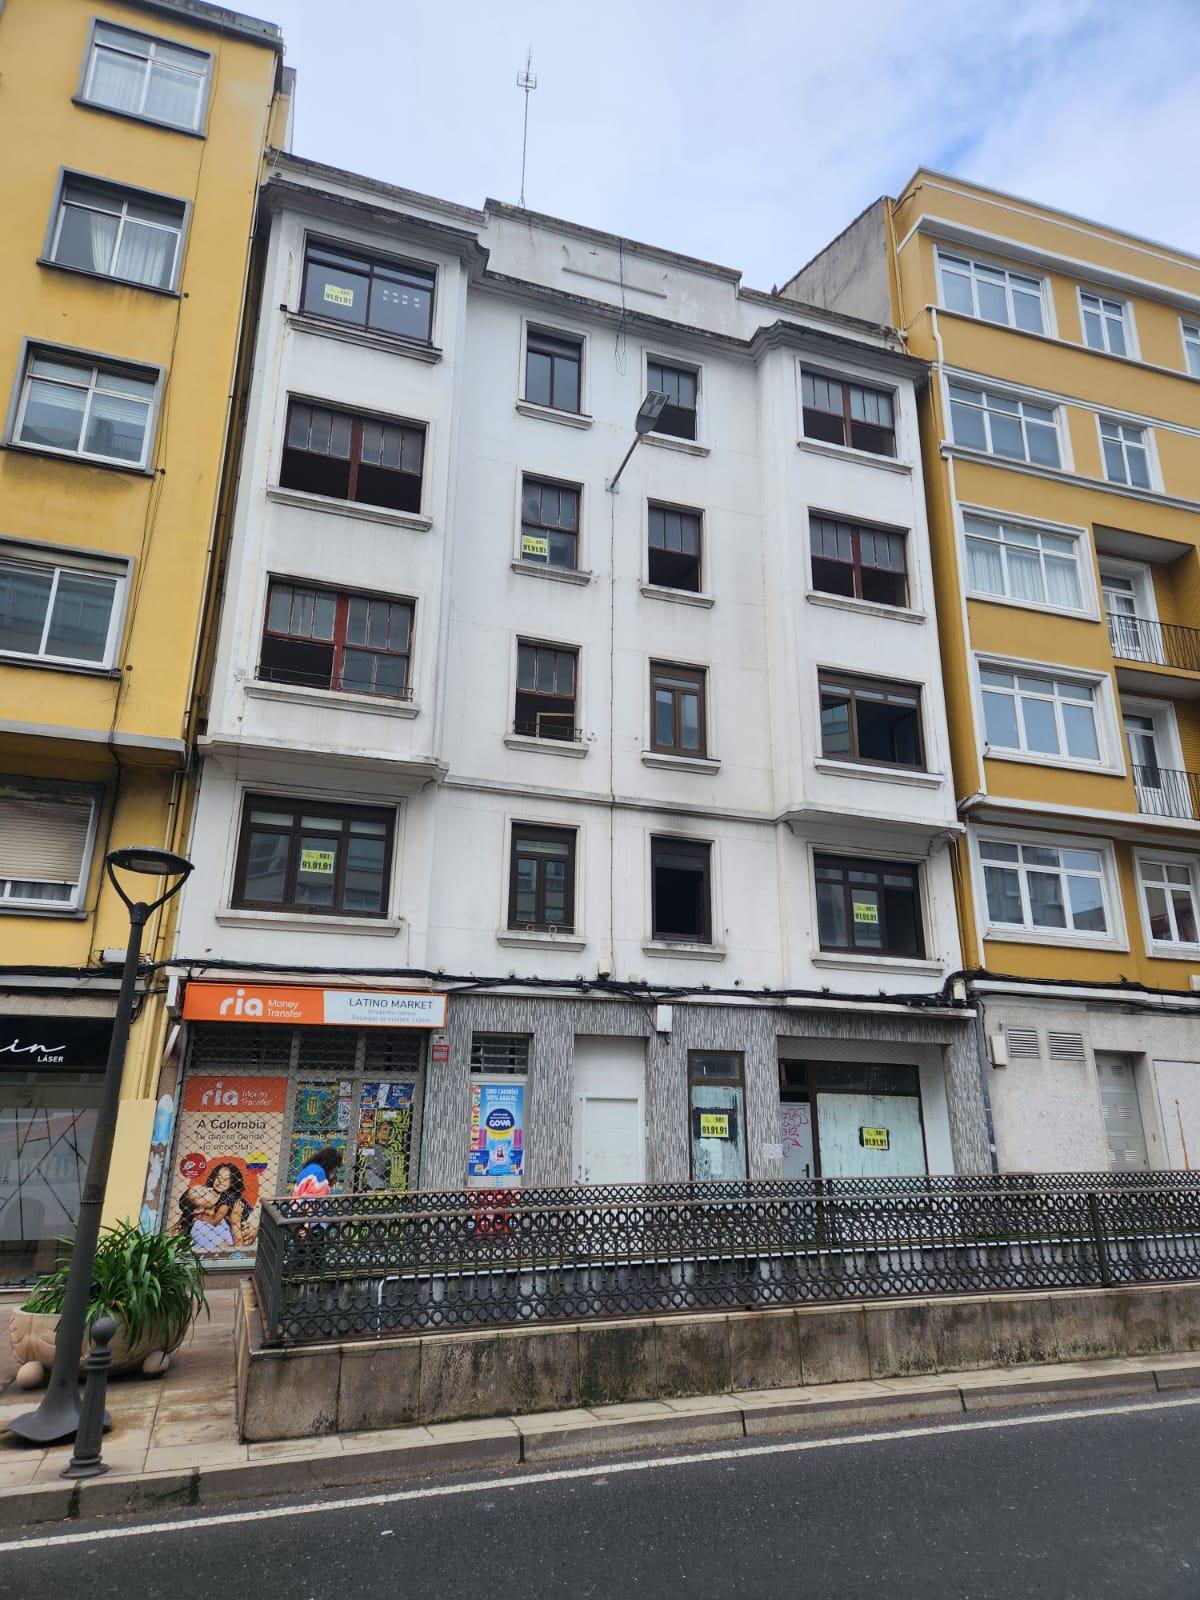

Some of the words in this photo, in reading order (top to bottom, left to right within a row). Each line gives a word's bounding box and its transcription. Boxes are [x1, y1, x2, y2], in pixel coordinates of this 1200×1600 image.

[219, 988, 264, 1017] ria
[267, 999, 299, 1010] Money
[349, 997, 388, 1008] LATINO
[391, 1000, 433, 1010] MARKET
[267, 1008, 303, 1018] Transfer
[37, 1055, 64, 1063] LÁSER
[201, 1082, 238, 1106] ria
[242, 1089, 268, 1098] Money
[240, 1098, 272, 1107] Transfer
[196, 1119, 206, 1128] A
[210, 1119, 266, 1129] Colombia
